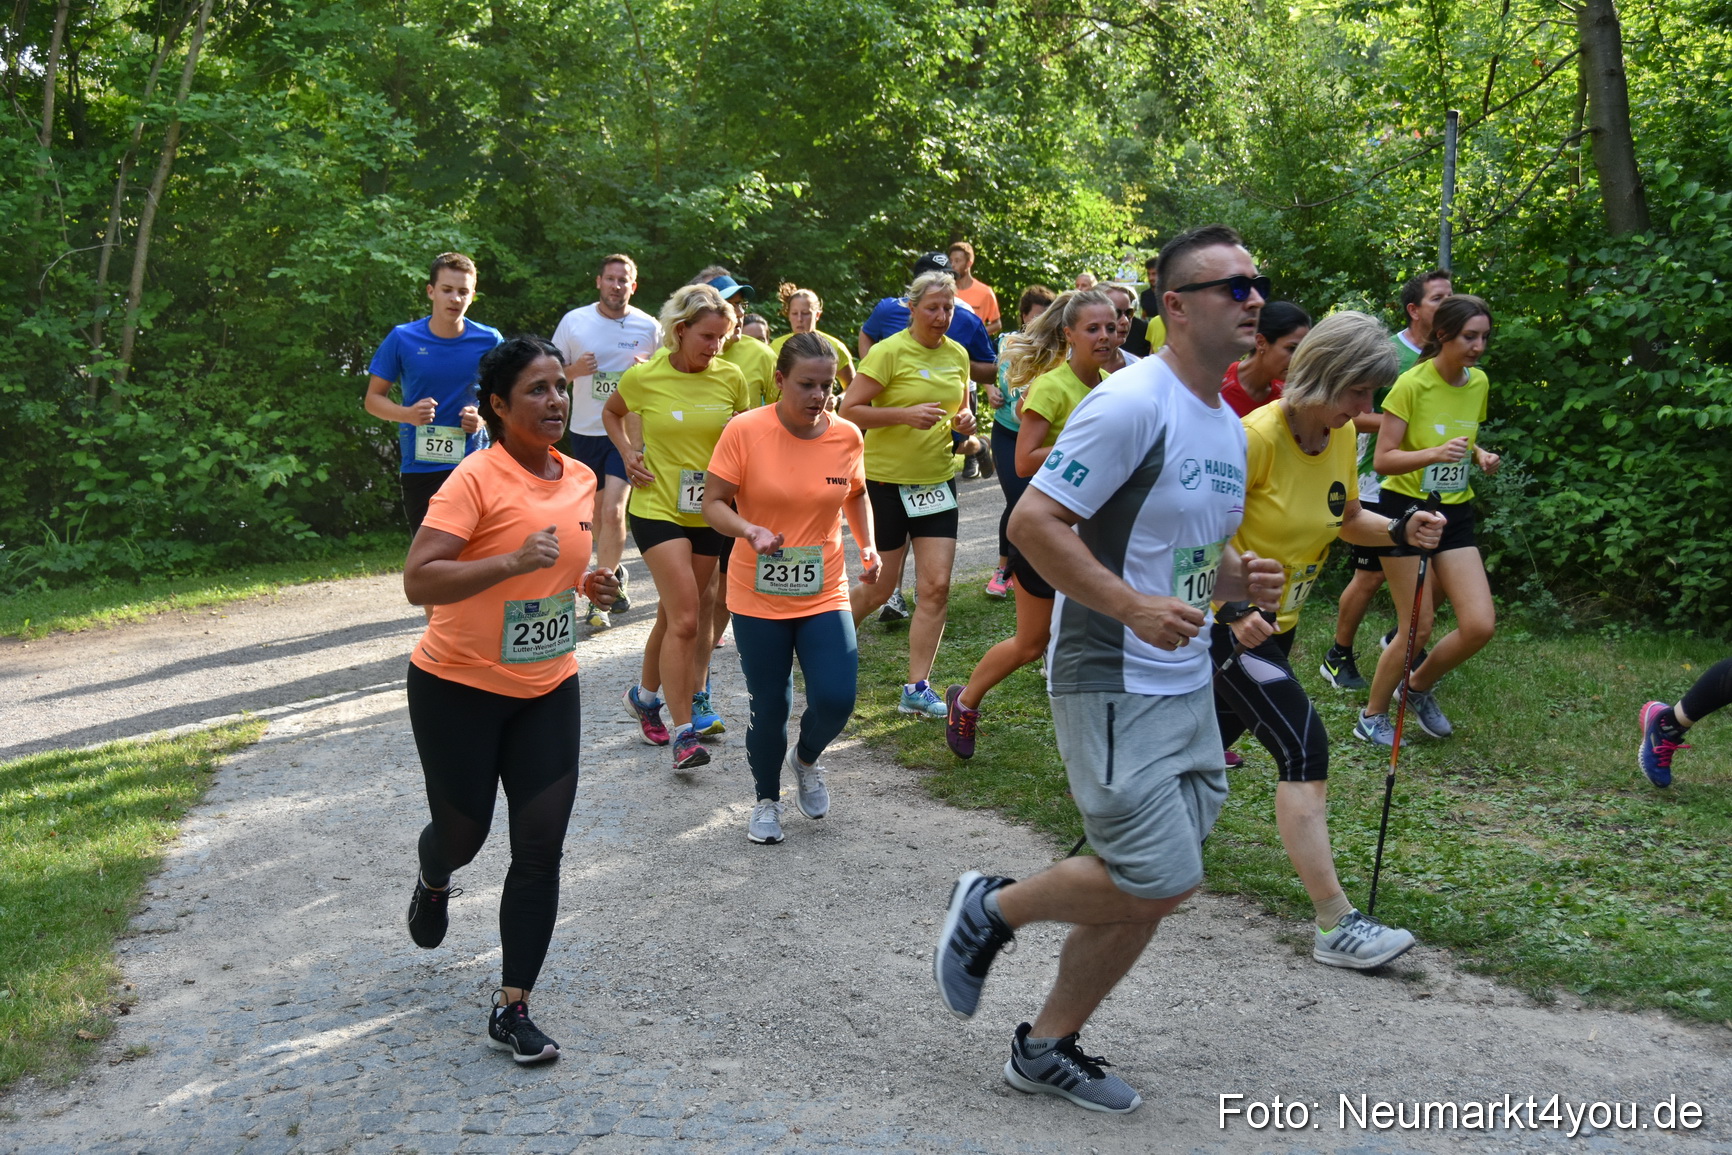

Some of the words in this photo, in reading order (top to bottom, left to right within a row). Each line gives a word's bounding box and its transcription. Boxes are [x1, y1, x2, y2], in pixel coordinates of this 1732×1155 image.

[426, 438, 453, 453] 578
[1431, 466, 1465, 481] 1231
[908, 489, 946, 507] 1209
[763, 563, 815, 582] 2315
[1184, 568, 1217, 601] 100
[512, 614, 569, 646] 2302
[513, 639, 557, 653] Lutter-Weinert
[557, 637, 570, 646] Silvia
